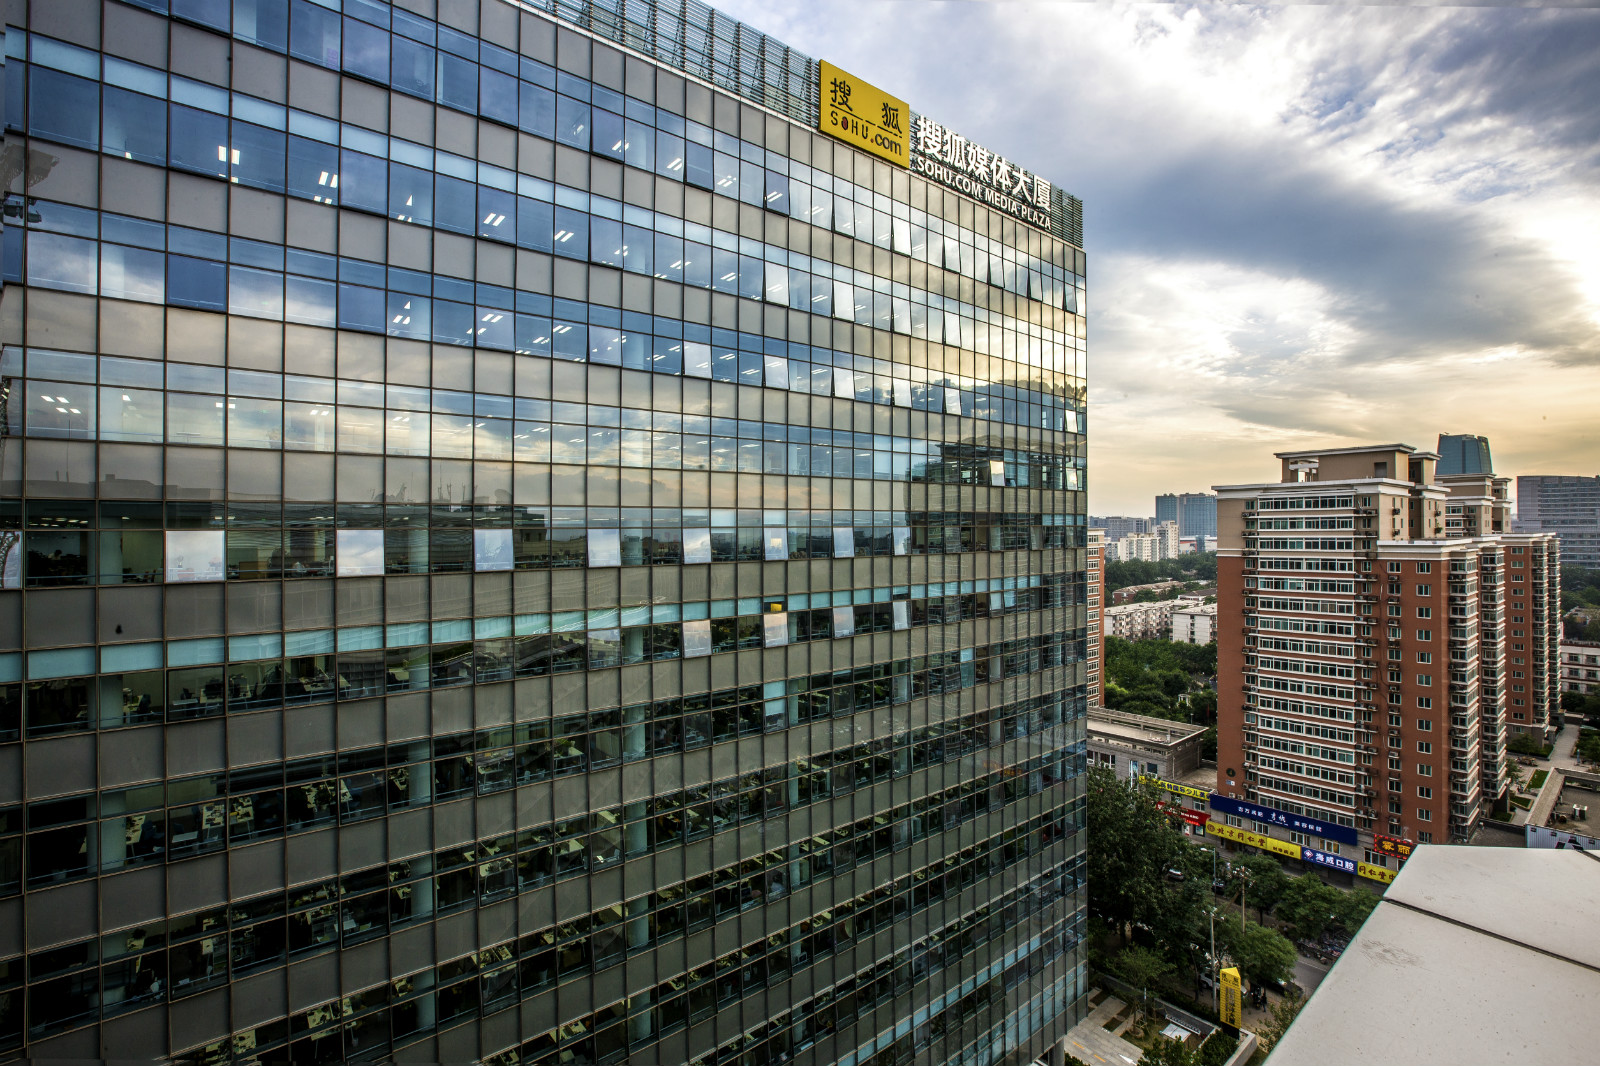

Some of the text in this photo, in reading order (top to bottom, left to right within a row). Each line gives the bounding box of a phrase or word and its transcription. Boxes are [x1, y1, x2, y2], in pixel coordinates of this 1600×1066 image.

[830, 110, 902, 156] SOHU.com
[917, 115, 1051, 212] 搜狐媒体大厦
[917, 156, 1051, 230] SOHU.COM MEDIA PLAZA
[1217, 827, 1266, 847] 北京同仁堂
